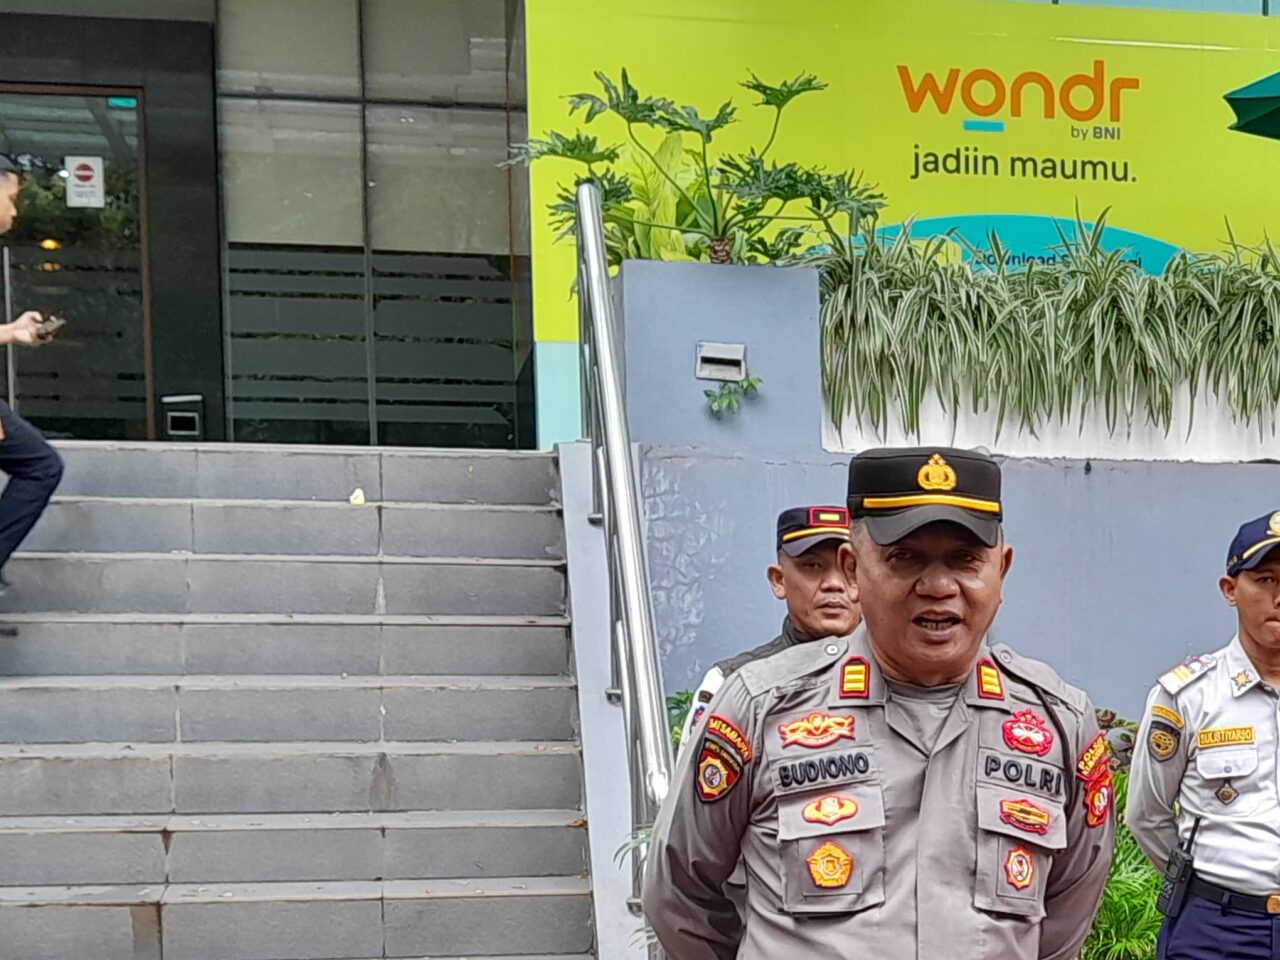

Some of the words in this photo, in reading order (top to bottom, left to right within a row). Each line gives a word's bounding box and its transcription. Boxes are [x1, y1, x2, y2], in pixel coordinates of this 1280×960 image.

[896, 60, 1140, 122] wondr
[1071, 125, 1088, 140] by
[1093, 126, 1121, 140] BNI
[910, 143, 999, 180] jadiin
[1010, 156, 1137, 183] maumu.
[778, 752, 869, 787] BUDIONO
[984, 755, 1062, 795] POLRI
